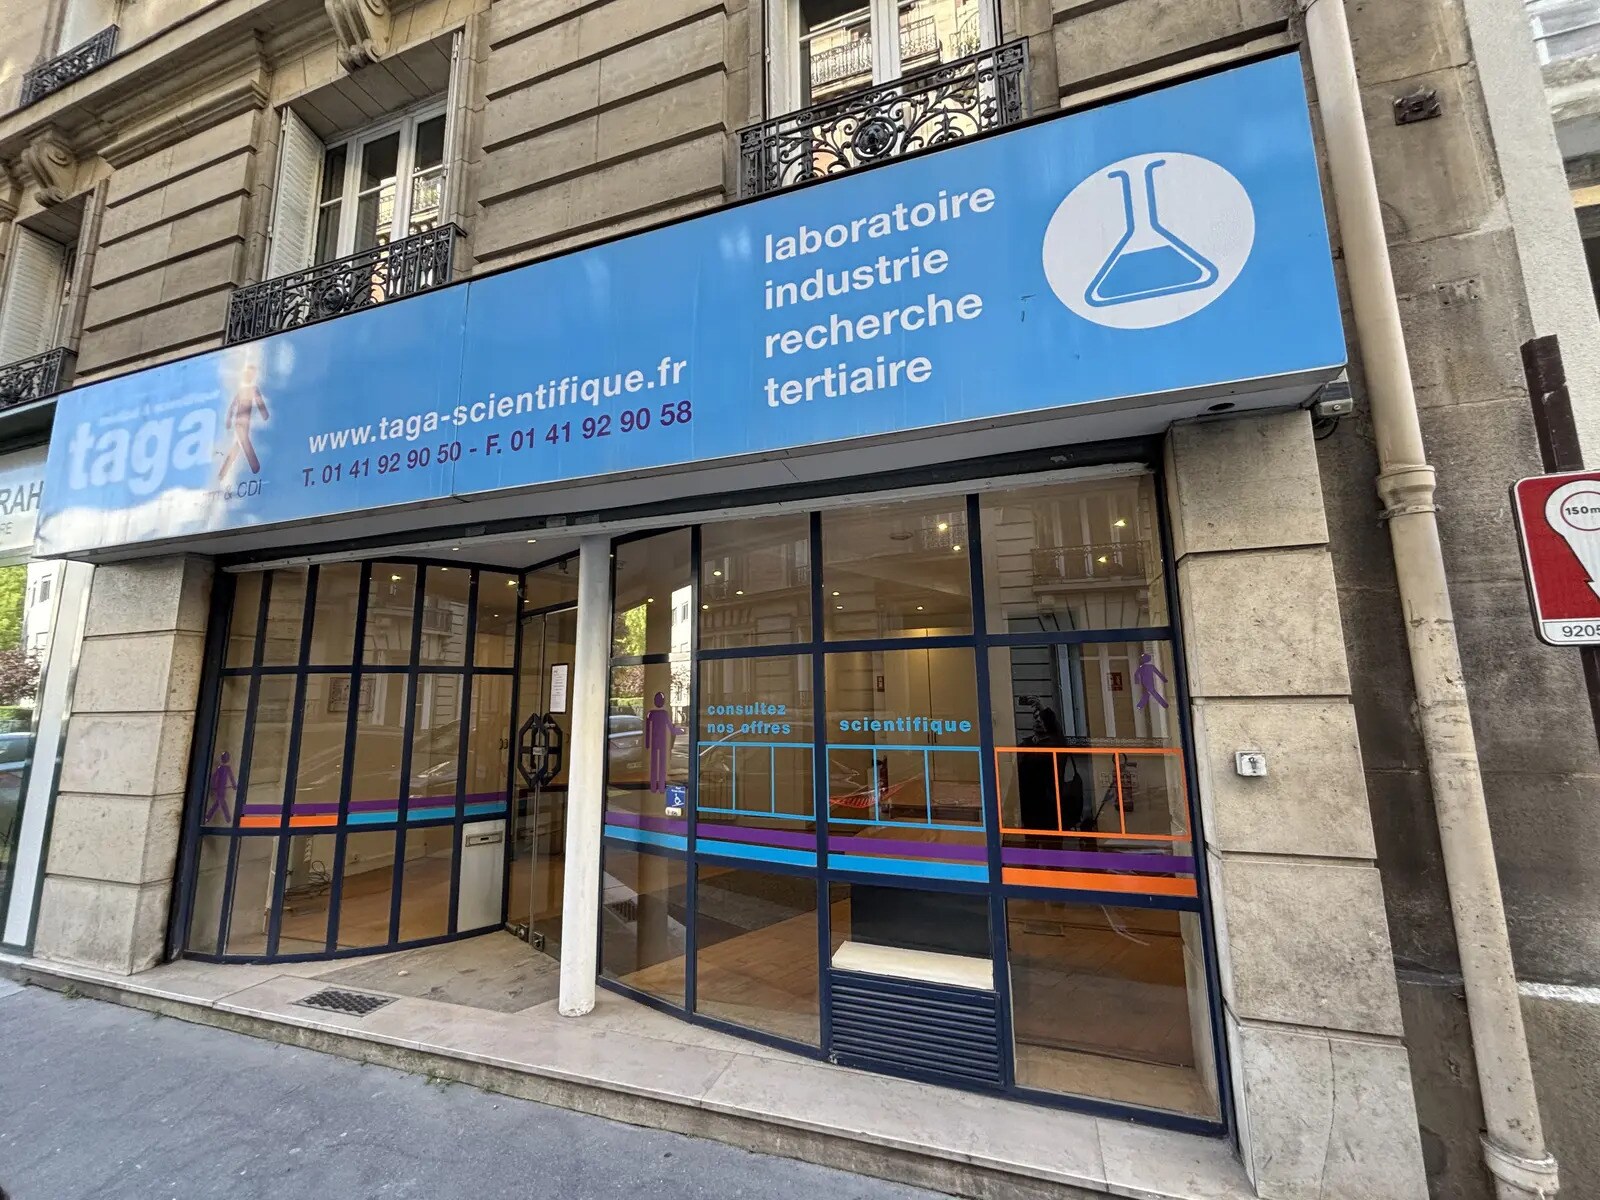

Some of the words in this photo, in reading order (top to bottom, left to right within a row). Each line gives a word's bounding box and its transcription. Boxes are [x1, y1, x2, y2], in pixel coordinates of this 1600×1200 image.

[764, 187, 996, 263] laboratoire
[764, 246, 949, 310] industrie
[764, 293, 983, 358] recherche
[309, 356, 687, 454] www.taga-scientifique.fr
[764, 355, 933, 408] tertiaire
[69, 407, 217, 495] taga
[302, 467, 315, 487] T.
[322, 463, 342, 484] 01
[349, 457, 370, 479] 41
[377, 452, 401, 475] 92
[406, 447, 431, 470] 90
[436, 441, 462, 464] 50
[485, 433, 502, 456] F.
[510, 427, 535, 452] 01
[545, 421, 571, 445] 41
[581, 414, 612, 440] 92
[620, 407, 650, 433] 90
[660, 400, 693, 427] 58
[237, 479, 263, 499] CDI
[707, 702, 786, 716] consultez
[707, 721, 734, 734] nos
[741, 720, 791, 735] offres
[839, 717, 972, 735] scientifique
